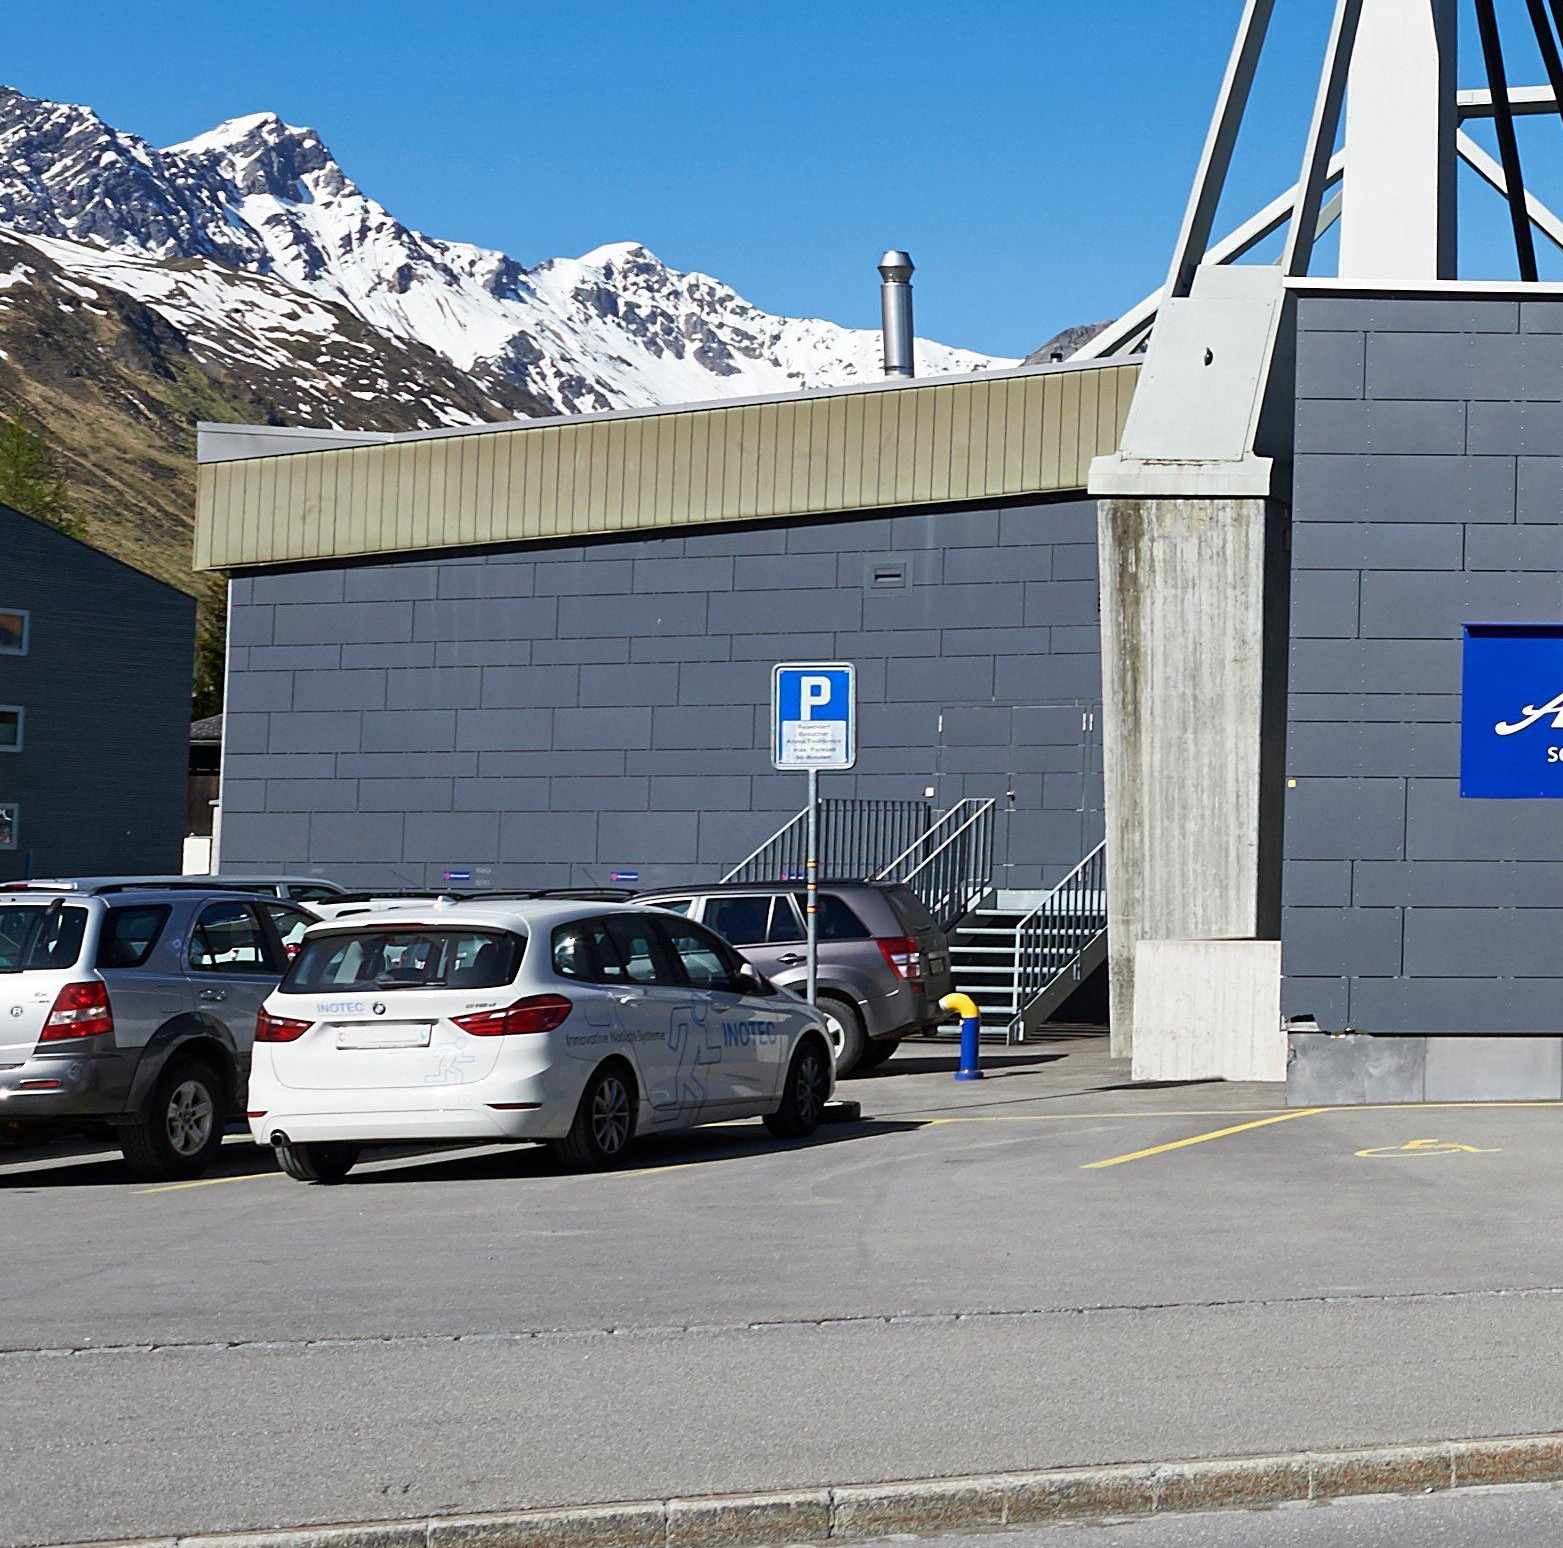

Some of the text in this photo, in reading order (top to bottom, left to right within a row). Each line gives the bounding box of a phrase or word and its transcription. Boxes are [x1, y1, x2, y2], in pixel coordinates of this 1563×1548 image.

[801, 676, 831, 721] P
[317, 1001, 364, 1013] INOTEC
[722, 1020, 777, 1047] INOTEC
